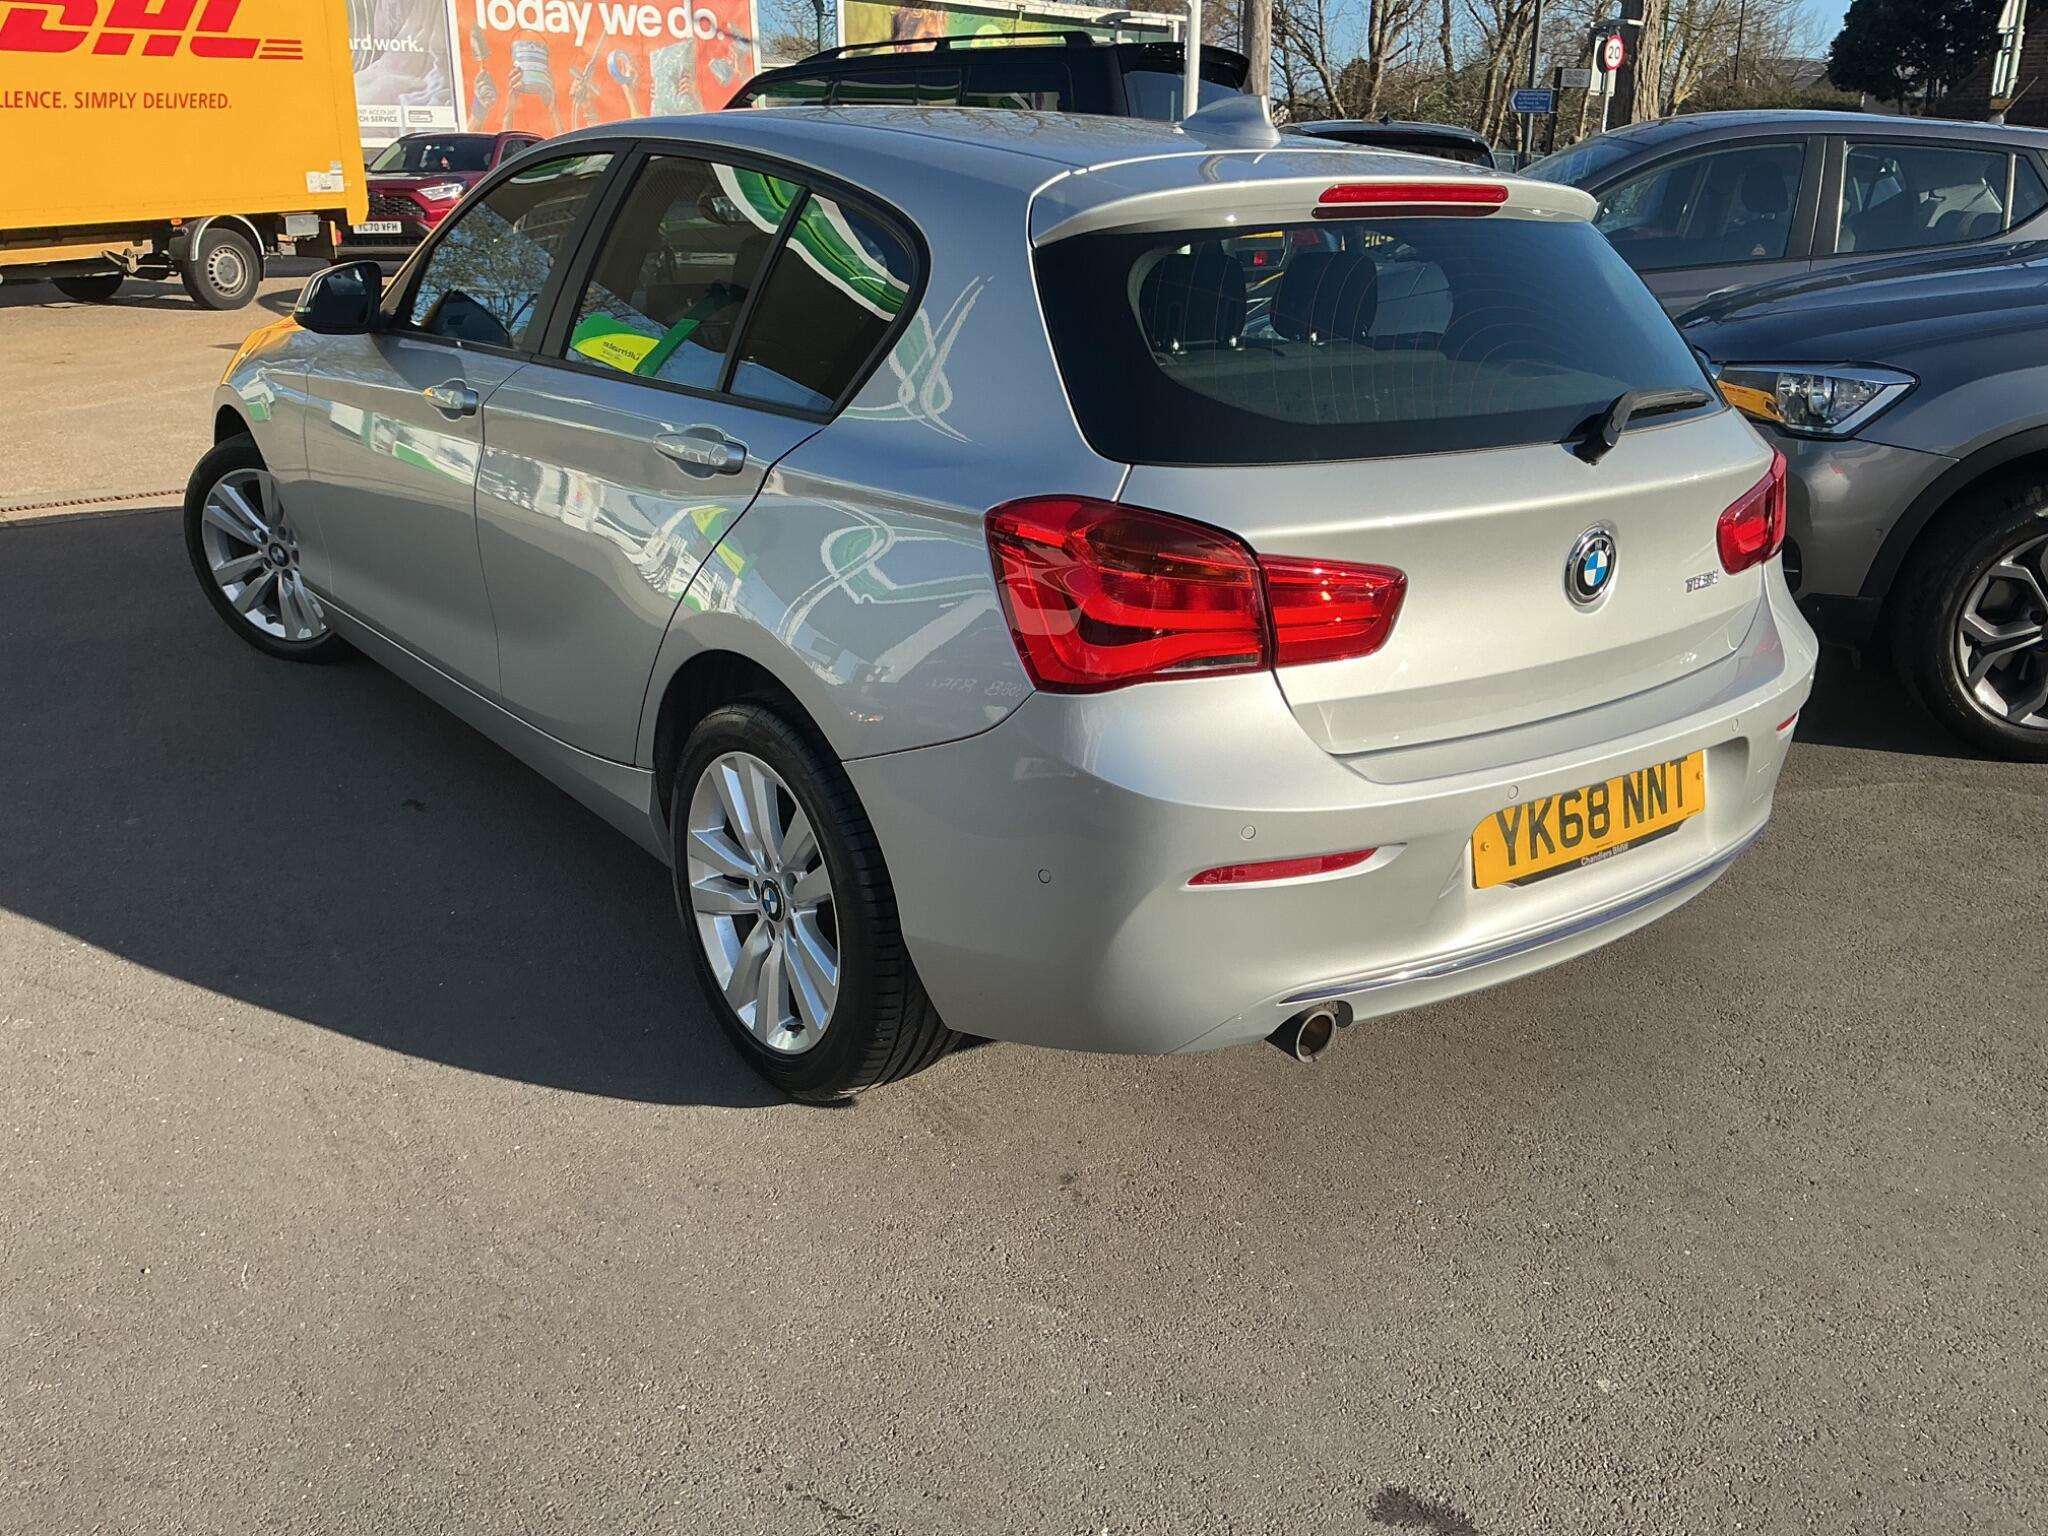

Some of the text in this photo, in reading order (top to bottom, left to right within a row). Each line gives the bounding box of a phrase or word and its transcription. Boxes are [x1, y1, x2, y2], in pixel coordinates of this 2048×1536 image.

[0, 0, 261, 58] DHL
[598, 1, 663, 37] we
[667, 0, 726, 41] do.
[374, 35, 425, 53] work.
[1608, 46, 1621, 60] 20
[74, 91, 137, 109] SIMPLY
[143, 92, 232, 109] DELIVERED.
[1495, 756, 1688, 867] YK68 NNT
[1580, 849, 1612, 867] Chandlers
